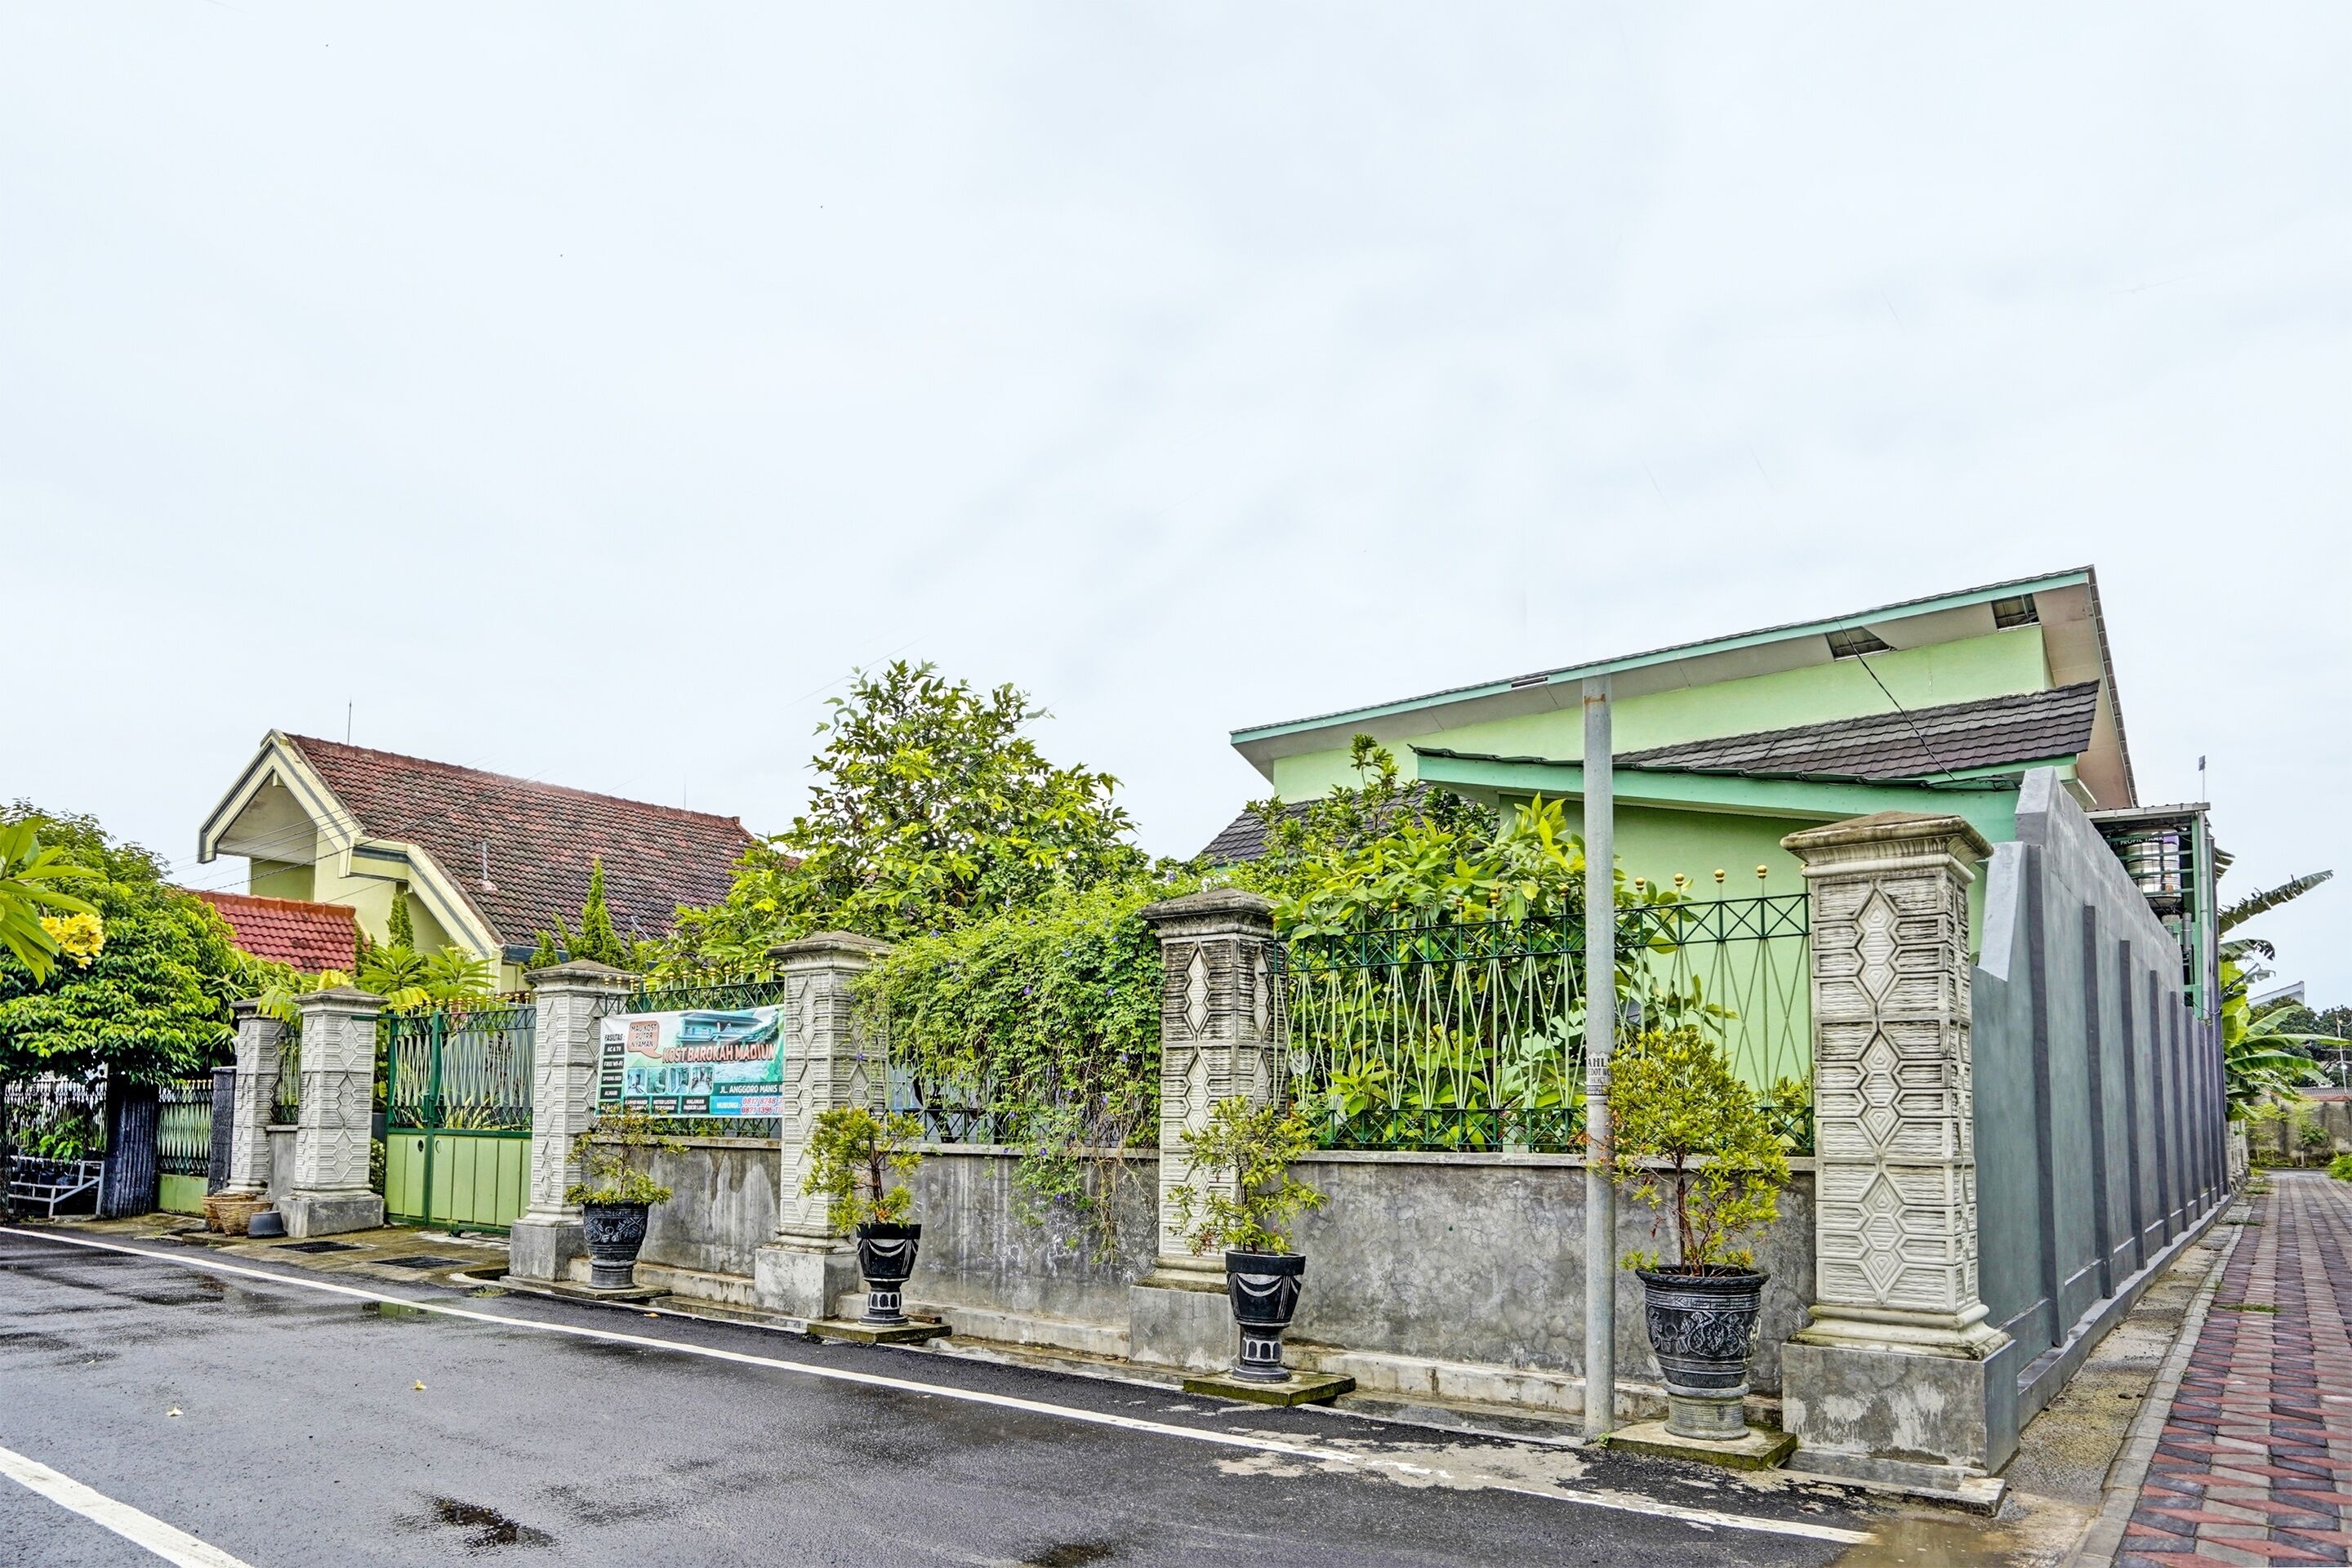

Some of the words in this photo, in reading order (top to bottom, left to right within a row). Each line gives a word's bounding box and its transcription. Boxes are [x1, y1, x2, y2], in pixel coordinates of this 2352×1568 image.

[644, 1023, 657, 1031] KOST
[662, 1047, 687, 1063] KOST
[688, 1045, 733, 1062] BAROKAH
[735, 1044, 776, 1062] MADIUN
[729, 1085, 759, 1094] ANGGORO
[760, 1084, 778, 1093] MANIS
